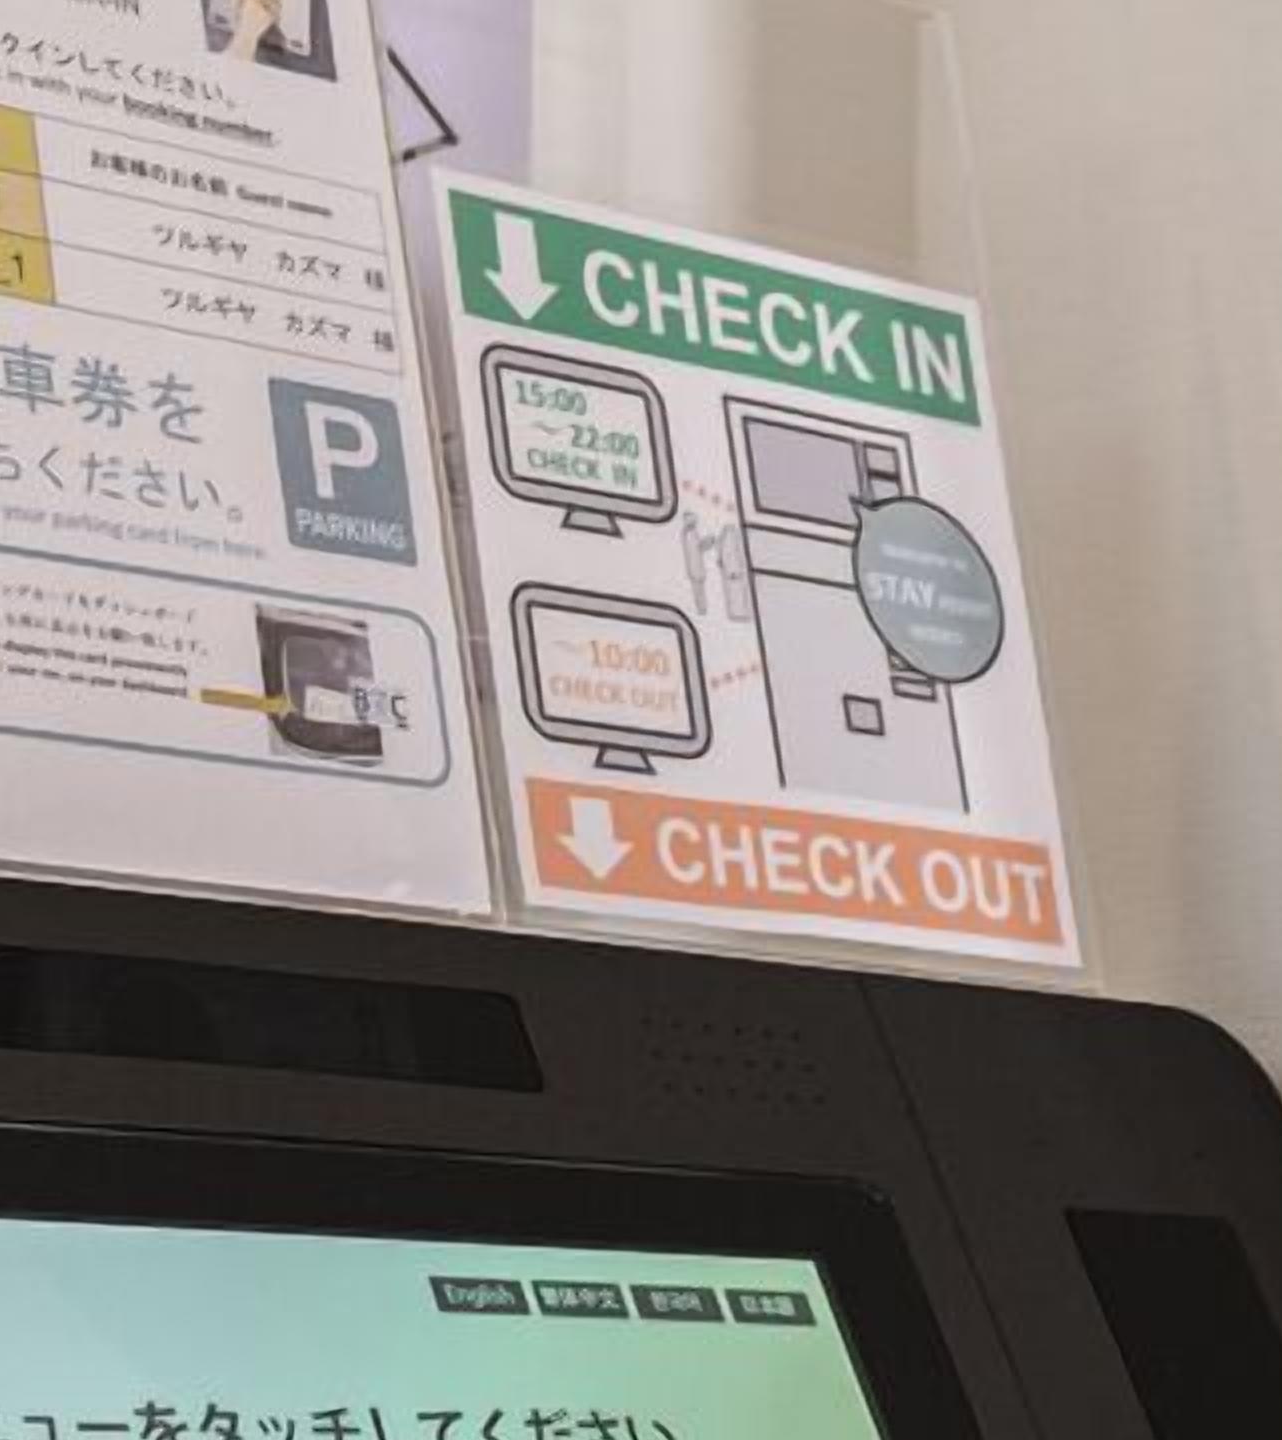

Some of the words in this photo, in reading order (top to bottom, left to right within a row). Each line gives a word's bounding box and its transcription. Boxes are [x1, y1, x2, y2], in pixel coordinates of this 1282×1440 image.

[582, 249, 875, 385] CHECK
[889, 319, 967, 404] IN
[515, 377, 588, 418] 15:00
[304, 400, 379, 500] P
[527, 447, 604, 481] CHECK
[611, 460, 639, 489] IN
[296, 507, 407, 552] PARKING
[864, 570, 935, 610] STAY
[548, 675, 623, 708] CHECK
[627, 681, 681, 713] OUT
[656, 817, 904, 908] CHECK
[922, 850, 1047, 924] OUT
[442, 1283, 515, 1308] English
[740, 1295, 795, 1317] 日本語
